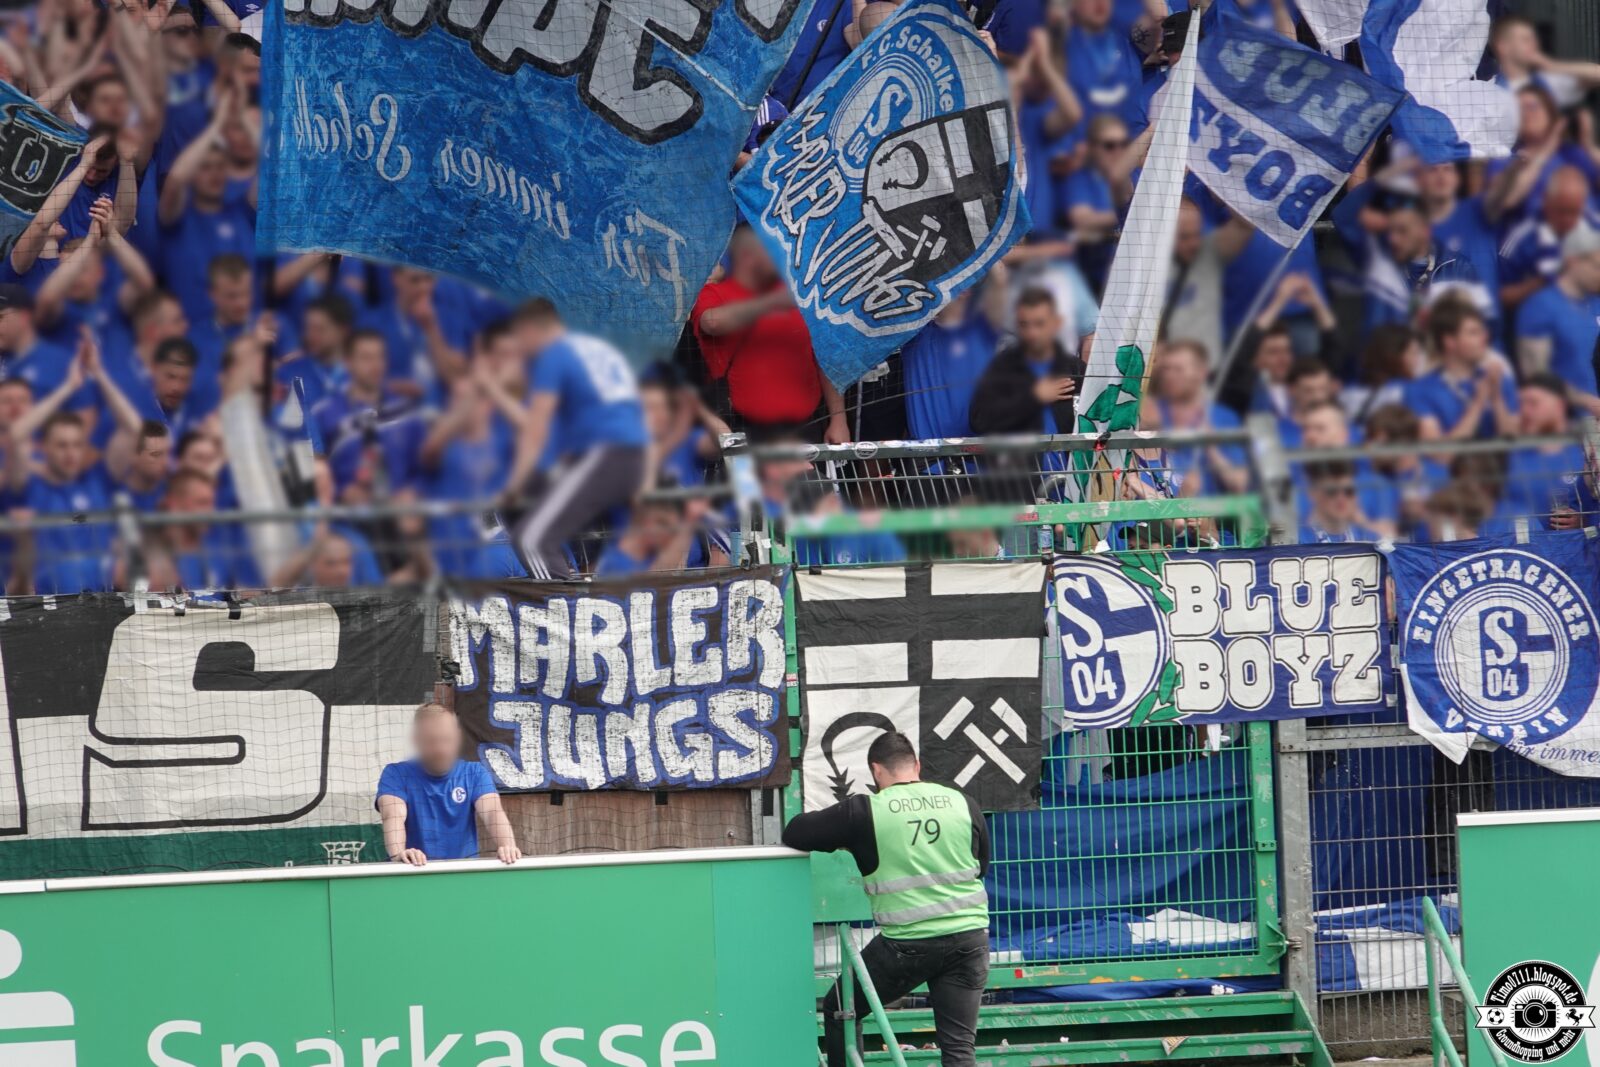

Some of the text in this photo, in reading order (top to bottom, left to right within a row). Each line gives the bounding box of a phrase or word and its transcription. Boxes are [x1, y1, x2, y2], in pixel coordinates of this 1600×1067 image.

[1056, 572, 1103, 659] S
[1163, 554, 1380, 637] BLUE
[1413, 558, 1590, 644] EINGETRAGENER
[450, 579, 786, 704] MARLER
[1173, 630, 1382, 713] BOYZ
[1484, 611, 1517, 666] S
[1070, 657, 1117, 706] 04
[1487, 668, 1519, 696] 04
[485, 690, 775, 790] JUNGS
[1540, 743, 1600, 763] imme
[888, 795, 952, 813] ORDNER
[907, 819, 941, 846] 79
